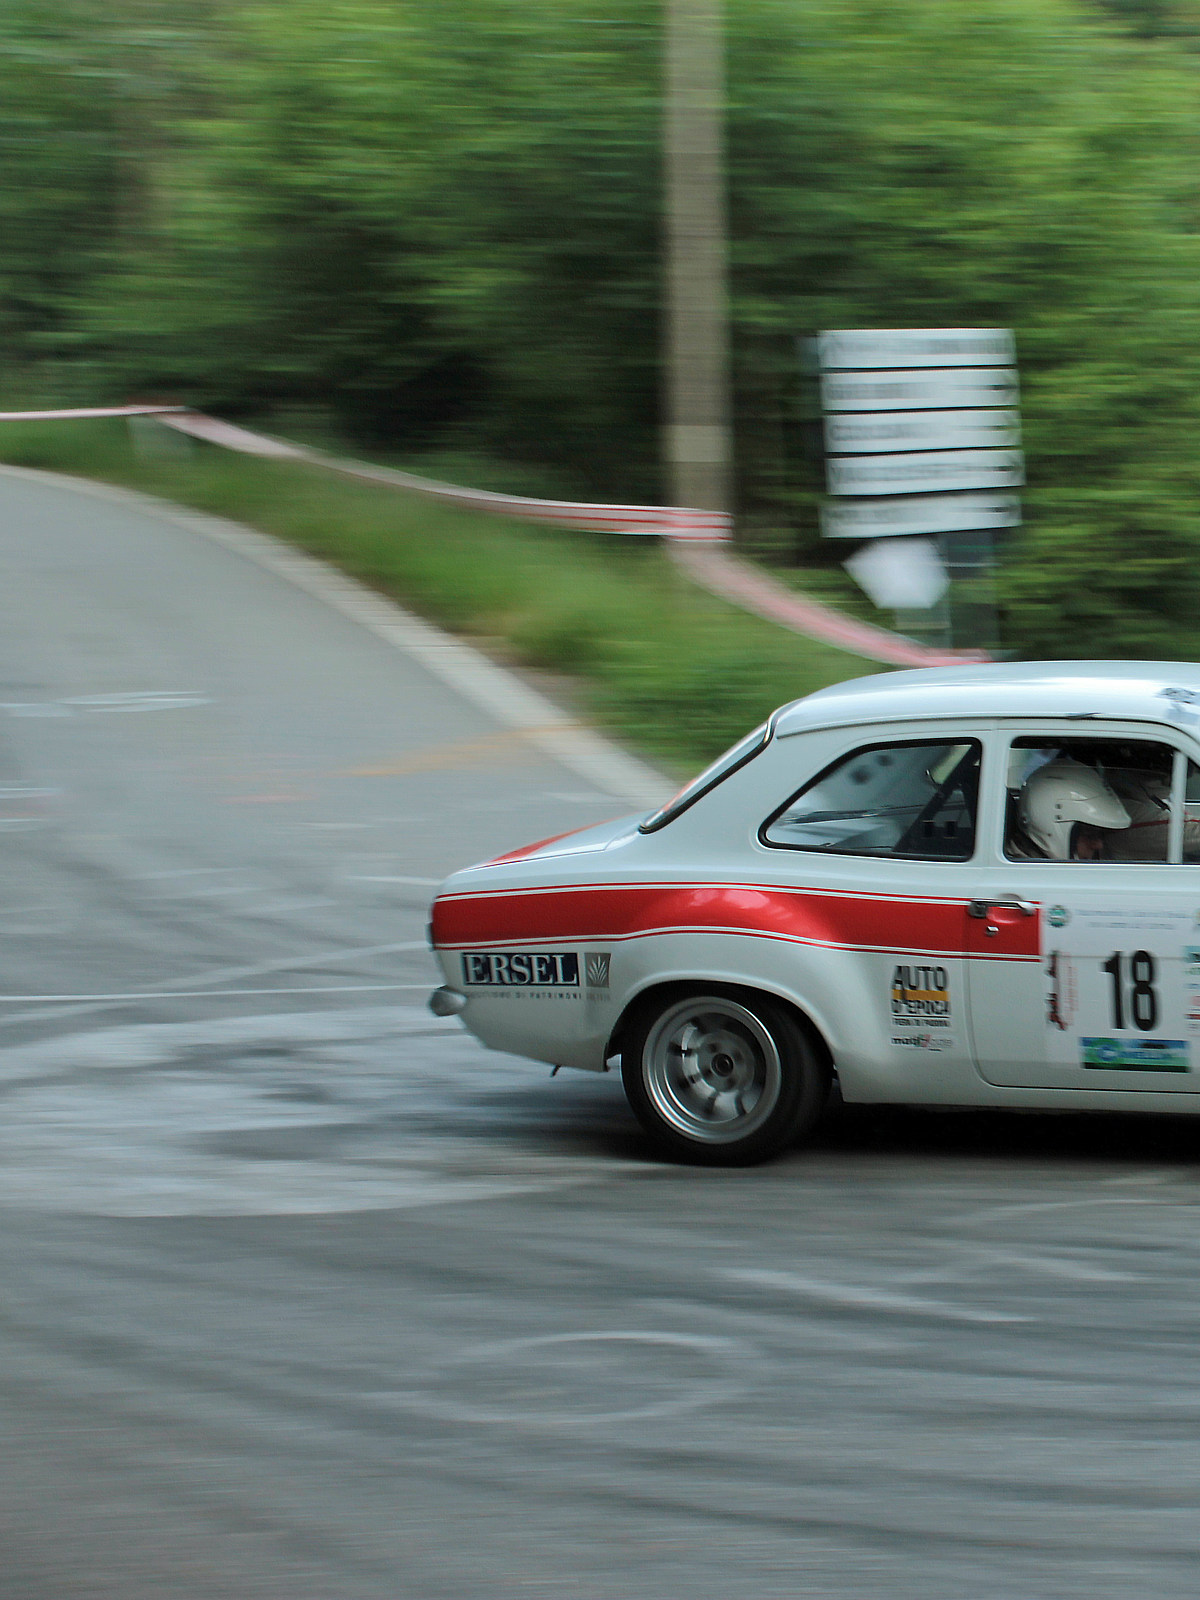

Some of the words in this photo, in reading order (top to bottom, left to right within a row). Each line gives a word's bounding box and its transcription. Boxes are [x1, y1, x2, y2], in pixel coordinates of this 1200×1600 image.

[463, 954, 577, 984] ERSEL
[892, 965, 948, 991] AUTO
[1102, 950, 1158, 1032] 18
